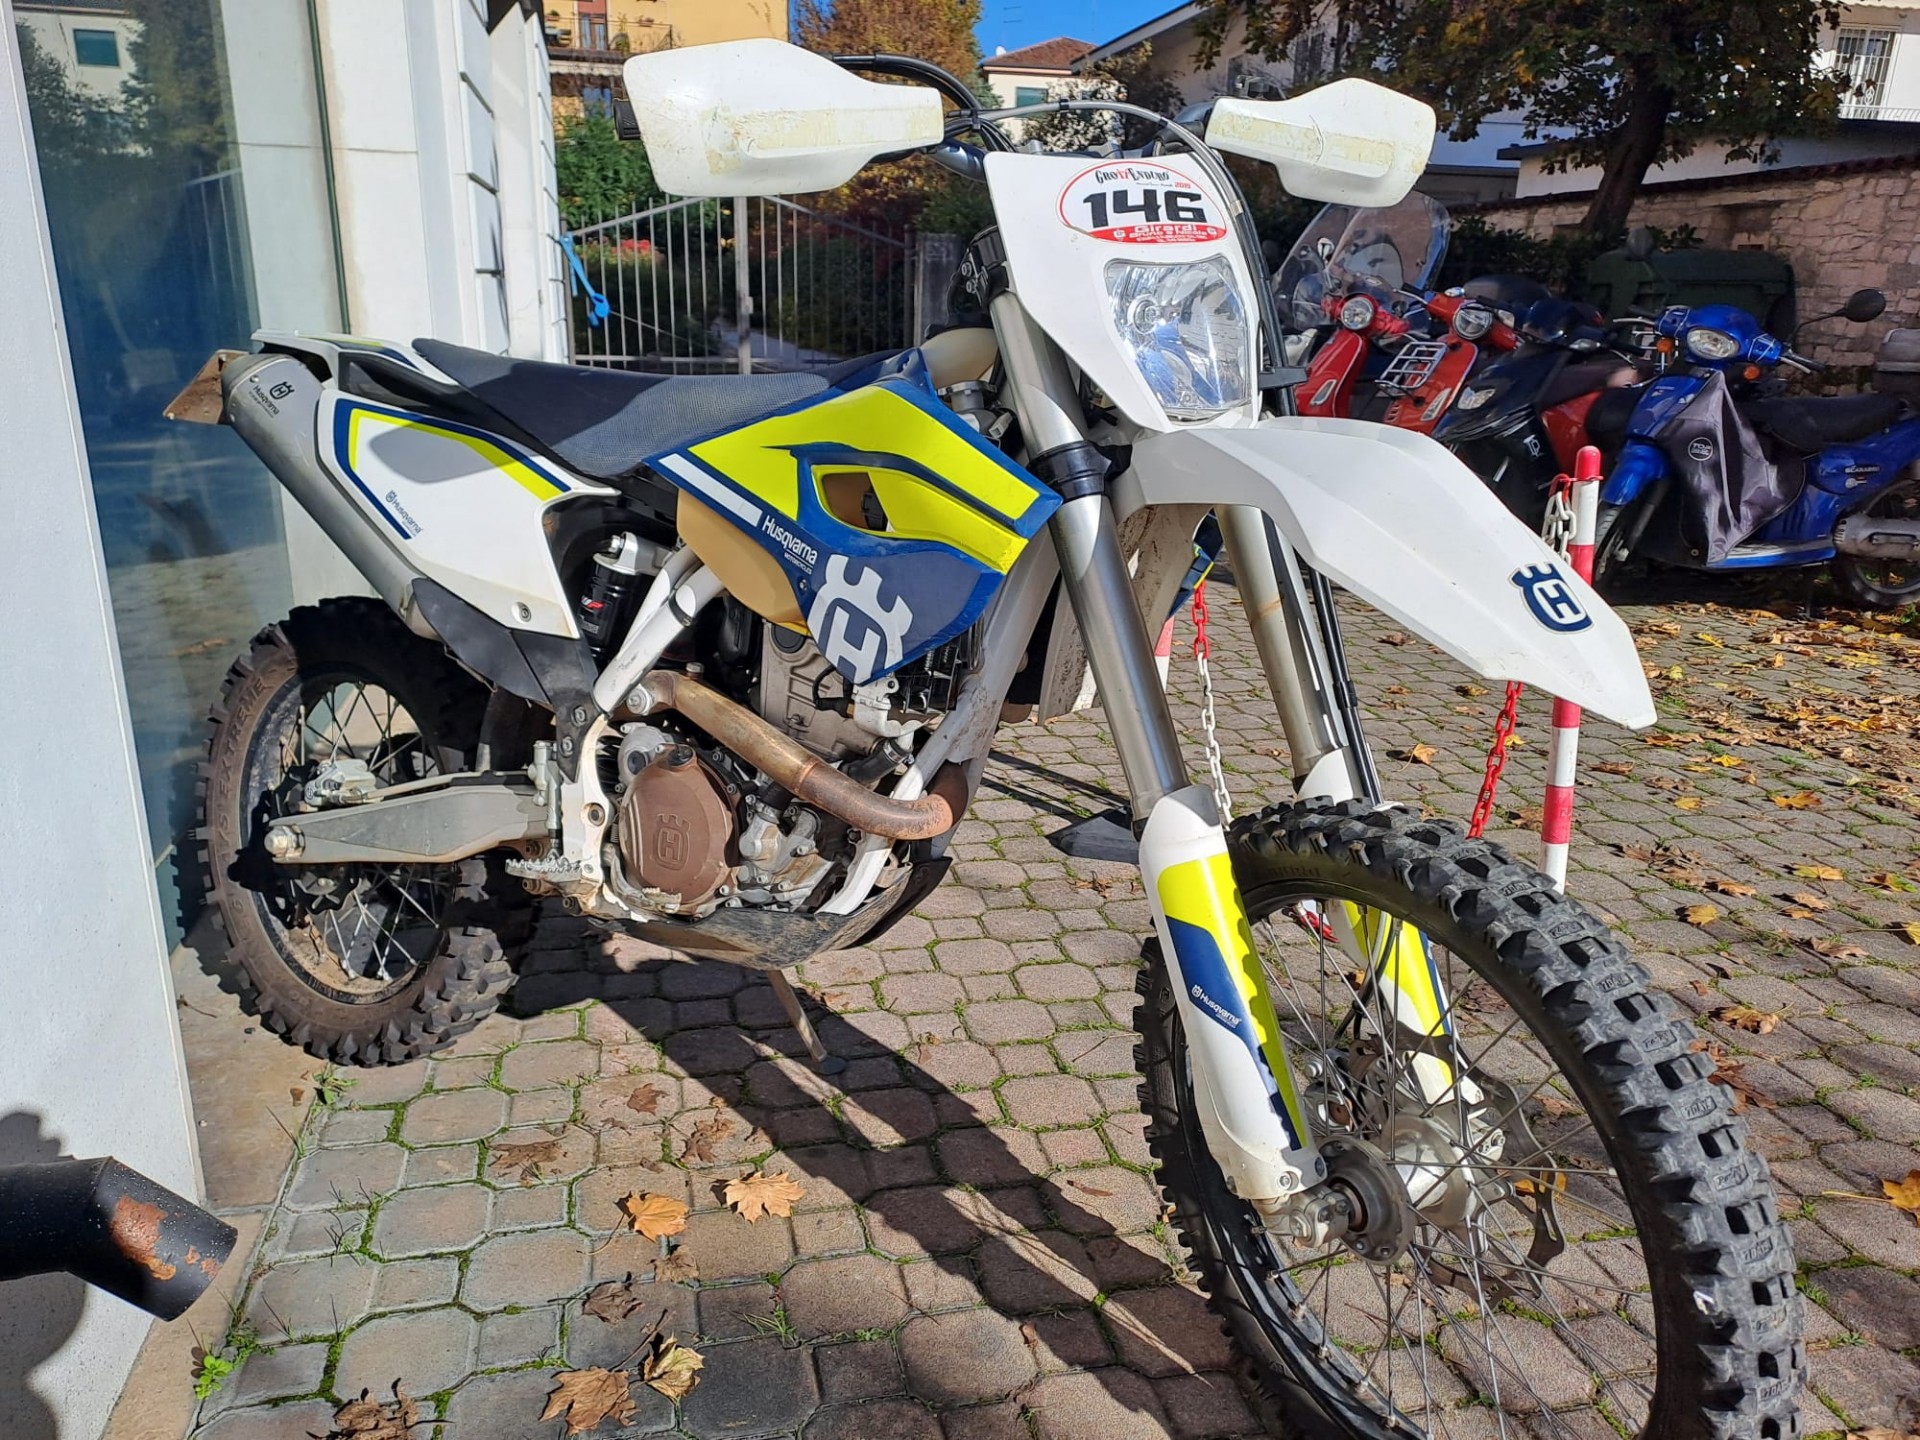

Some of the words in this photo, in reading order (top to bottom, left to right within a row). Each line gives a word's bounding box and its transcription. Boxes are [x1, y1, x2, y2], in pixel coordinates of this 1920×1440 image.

[1083, 189, 1207, 228] 146
[253, 384, 280, 415] Husqvarna
[391, 499, 423, 535] Husqvarna
[761, 514, 818, 565] Husqvarna
[219, 678, 267, 793] EXTREME
[1200, 994, 1240, 1027] Husqvarna
